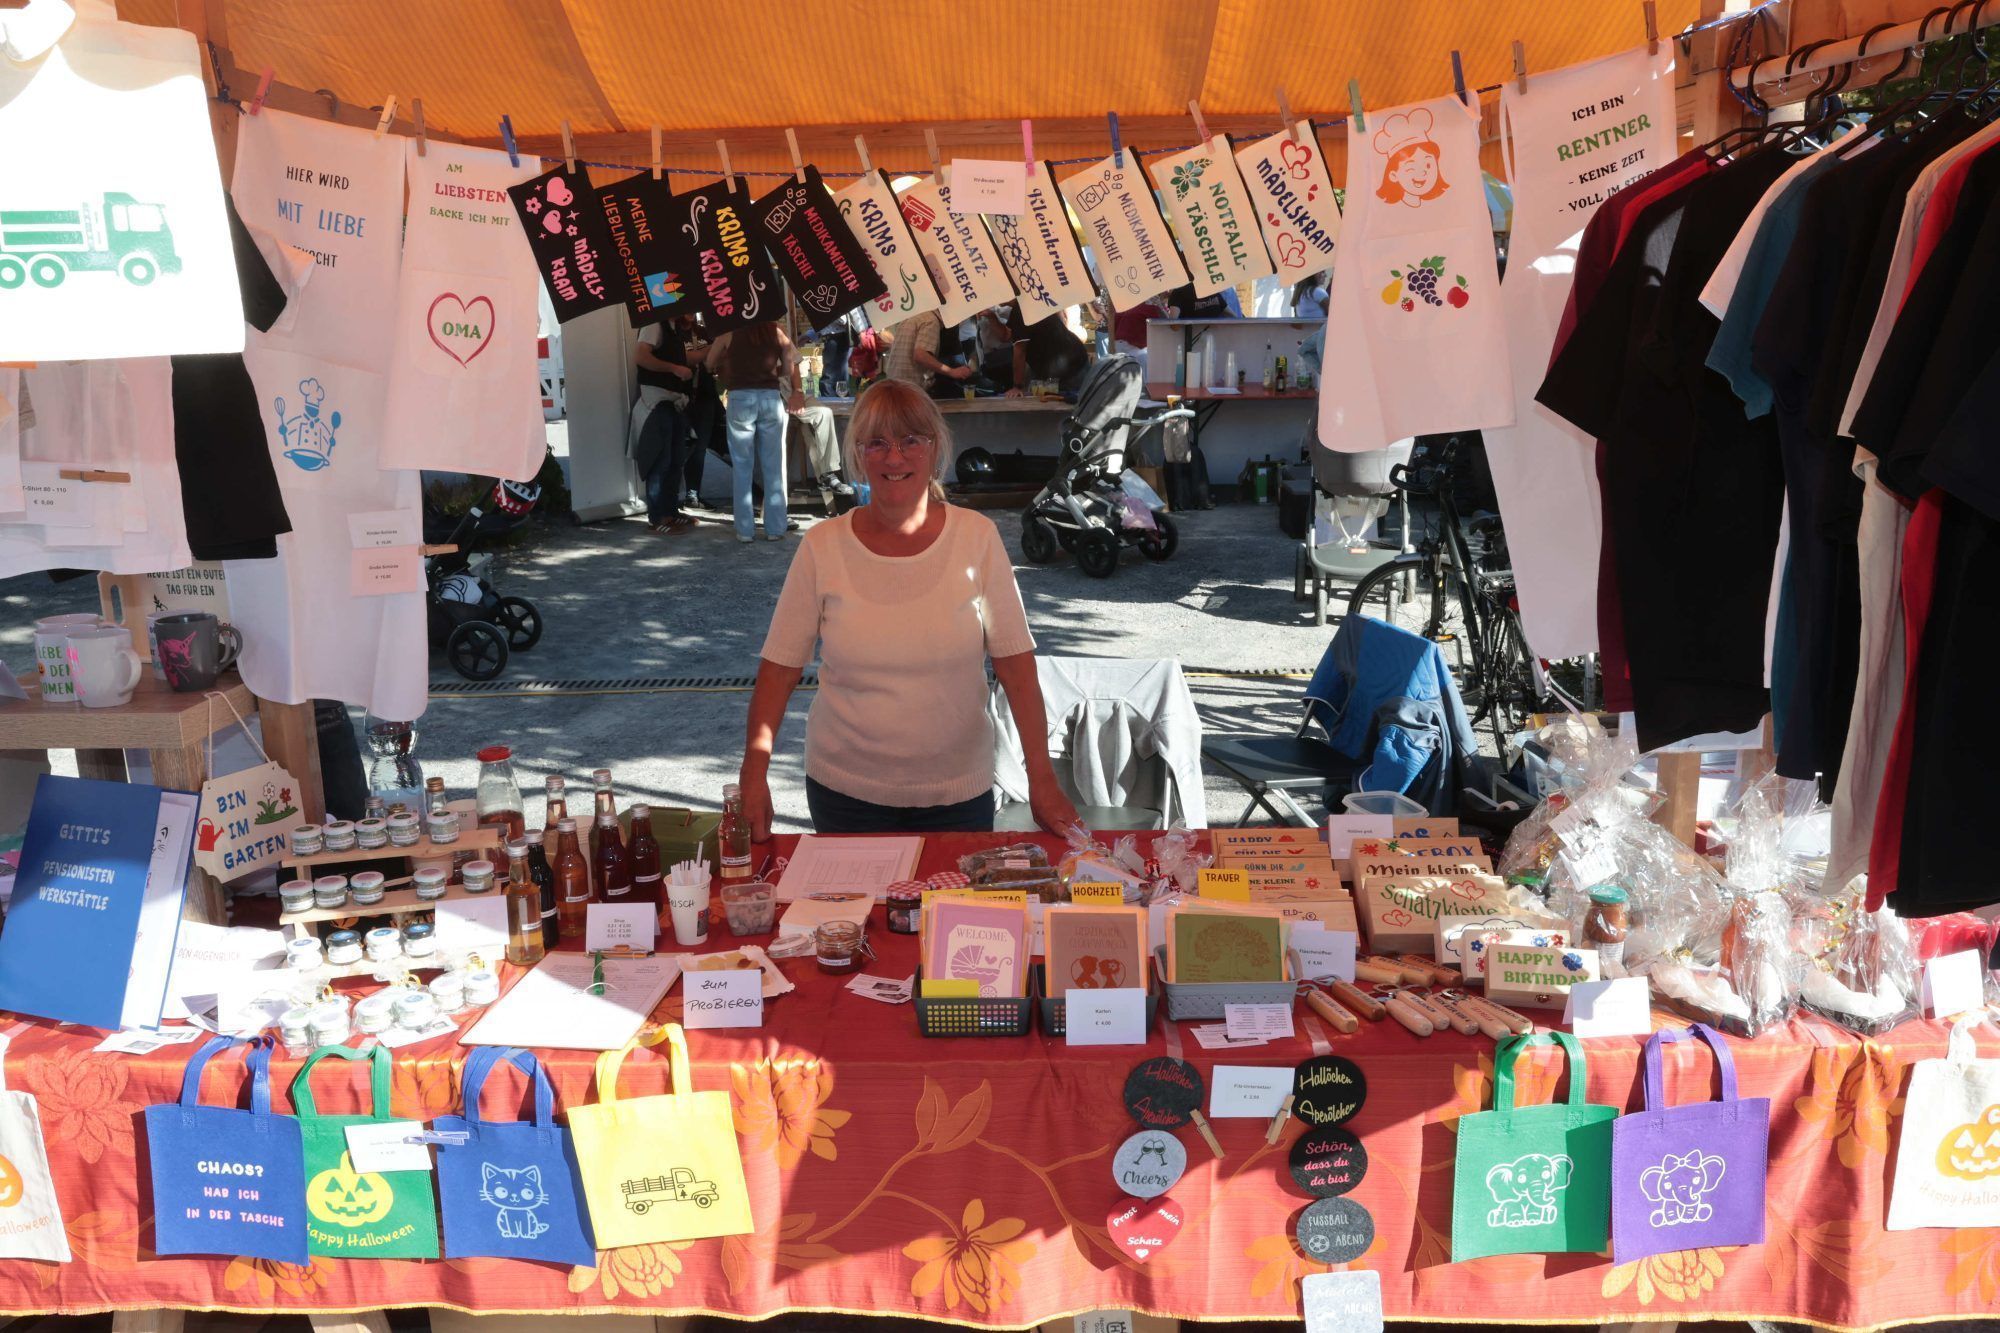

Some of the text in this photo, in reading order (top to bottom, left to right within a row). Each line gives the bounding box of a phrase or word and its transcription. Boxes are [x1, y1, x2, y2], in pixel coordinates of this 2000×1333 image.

[1572, 95, 1624, 121] ICH BIN
[1556, 114, 1651, 162] RENTNER
[446, 163, 463, 174] AM
[1578, 162, 1618, 184] KEINE
[1622, 149, 1645, 168] ZEIT
[286, 166, 350, 190] HIER WIRD
[434, 183, 508, 204] LIEBSTEN
[1568, 193, 1604, 212] VOLL
[429, 207, 511, 227] BACKE ICH MIT
[1256, 157, 1335, 255] MÄDELSKRAM
[277, 199, 366, 238] MIT LIEBE
[626, 197, 653, 244] MEINE
[859, 198, 896, 257] KRIMS
[1209, 181, 1248, 272] NOTFALL-
[716, 206, 750, 268] KRIMS
[1027, 187, 1071, 288] Kleinkram
[1092, 215, 1124, 265] TÄSCHLE
[1118, 191, 1164, 283] MEDIKAMENTEN-
[1186, 201, 1225, 286] TÄSCHLE
[602, 194, 651, 314] LIEBLINGSSTIFTE
[782, 233, 817, 281] TÄSCHLE
[803, 205, 861, 295] MEDIKAMENTEN-
[574, 237, 605, 300] MÄDELS-
[933, 224, 977, 303] APOTHEKE
[551, 257, 579, 301] KRAM
[700, 248, 735, 317] KRAMS
[441, 321, 482, 340] OMA
[172, 570, 185, 580] IST
[187, 568, 201, 580] EIN
[166, 584, 215, 596] TAG FÜR EIN
[216, 790, 247, 814] BIN
[60, 824, 111, 845] GITTI'S
[228, 819, 250, 840] IM
[223, 833, 286, 870] GARTEN
[43, 861, 115, 885] PENSIONISTEN
[1205, 873, 1240, 883] TRAUER
[1366, 863, 1488, 878] Mein kleines
[38, 886, 110, 911] WERKSTÄTTLE
[1073, 885, 1121, 898] HOCHZEIT
[956, 927, 1008, 943] WELCOME
[1497, 951, 1555, 966] HAPPY
[701, 979, 728, 991] ZUM
[1503, 970, 1589, 986] BIRTHDAY
[687, 997, 762, 1011] PROBIEREN
[1144, 1060, 1195, 1090] Hallöchen
[1299, 1066, 1353, 1091] Hallöchen
[1133, 1096, 1183, 1125] Aperölchen
[1299, 1099, 1356, 1125] Aperölchen
[1305, 1141, 1353, 1155] Schön,
[197, 1160, 264, 1178] CHAOS?
[1304, 1157, 1350, 1171] dass du
[1122, 1170, 1170, 1188] Cheers
[1310, 1173, 1350, 1186] da bist
[204, 1186, 259, 1201] HAB ICH
[1961, 1191, 2000, 1205] Hallo
[0, 1214, 51, 1235] alloween
[186, 1208, 285, 1227] IN DER TASCHE
[1112, 1206, 1138, 1227] Prost
[1308, 1214, 1350, 1231] FUSSBALL
[347, 1223, 416, 1247] Halloween
[1127, 1236, 1162, 1246] Schatz
[1335, 1234, 1365, 1247] ABEND
